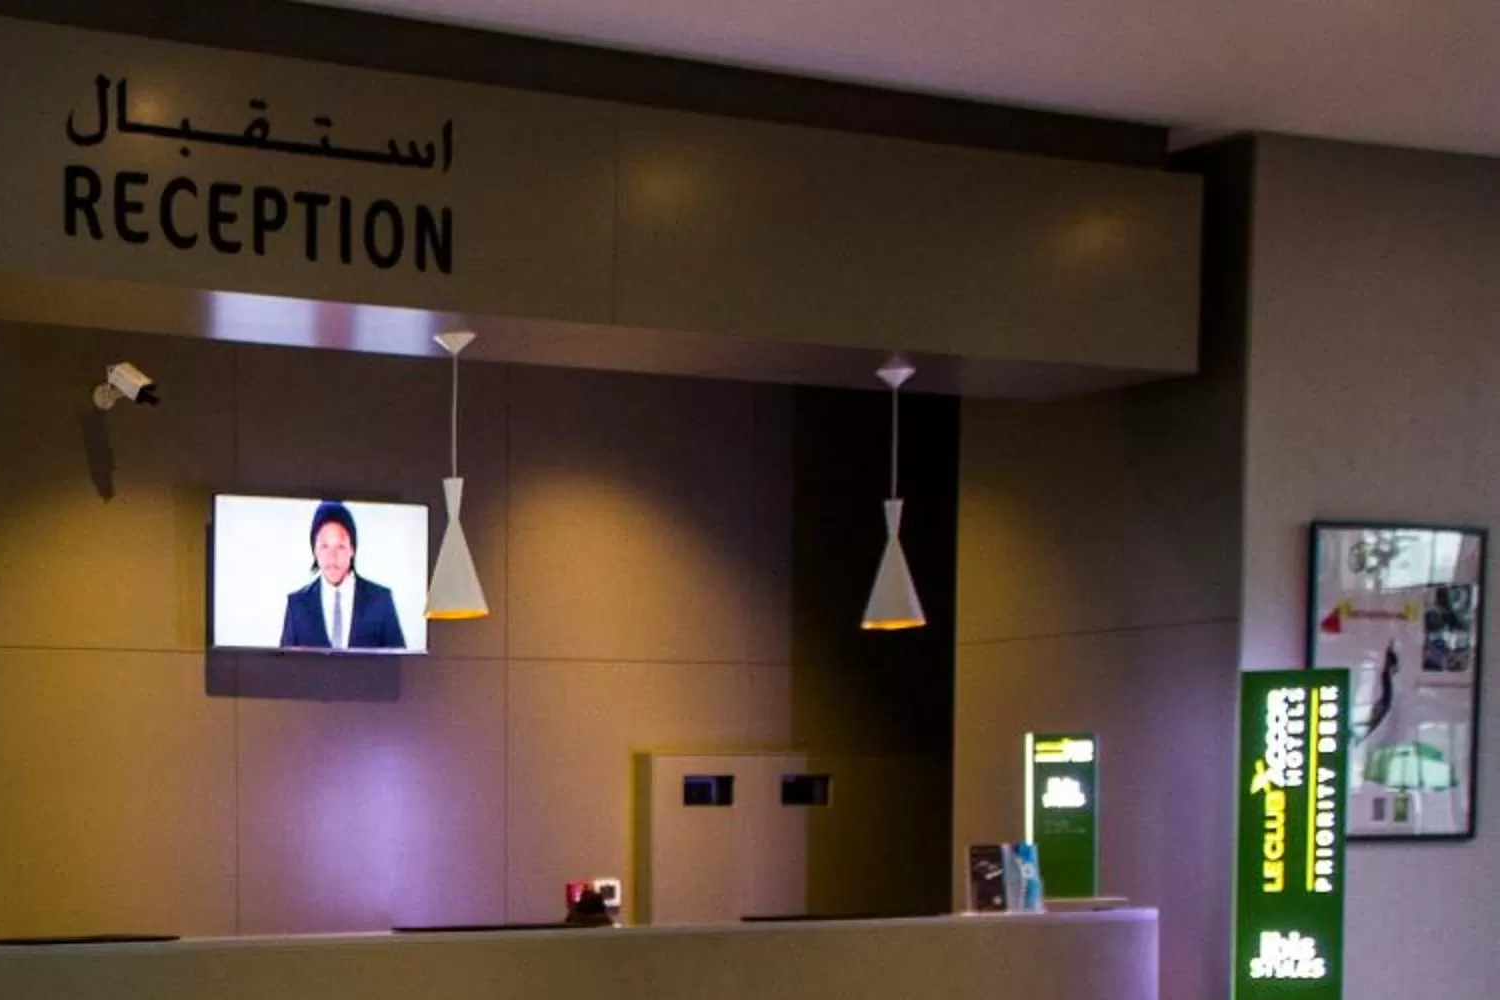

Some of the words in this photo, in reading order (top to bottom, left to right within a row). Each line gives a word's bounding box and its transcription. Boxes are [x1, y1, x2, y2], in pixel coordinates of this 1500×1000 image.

[66, 73, 453, 173] استقبال
[63, 164, 453, 275] RECEPTION
[1318, 685, 1339, 753] DESK
[1315, 767, 1337, 893] PRIORITY
